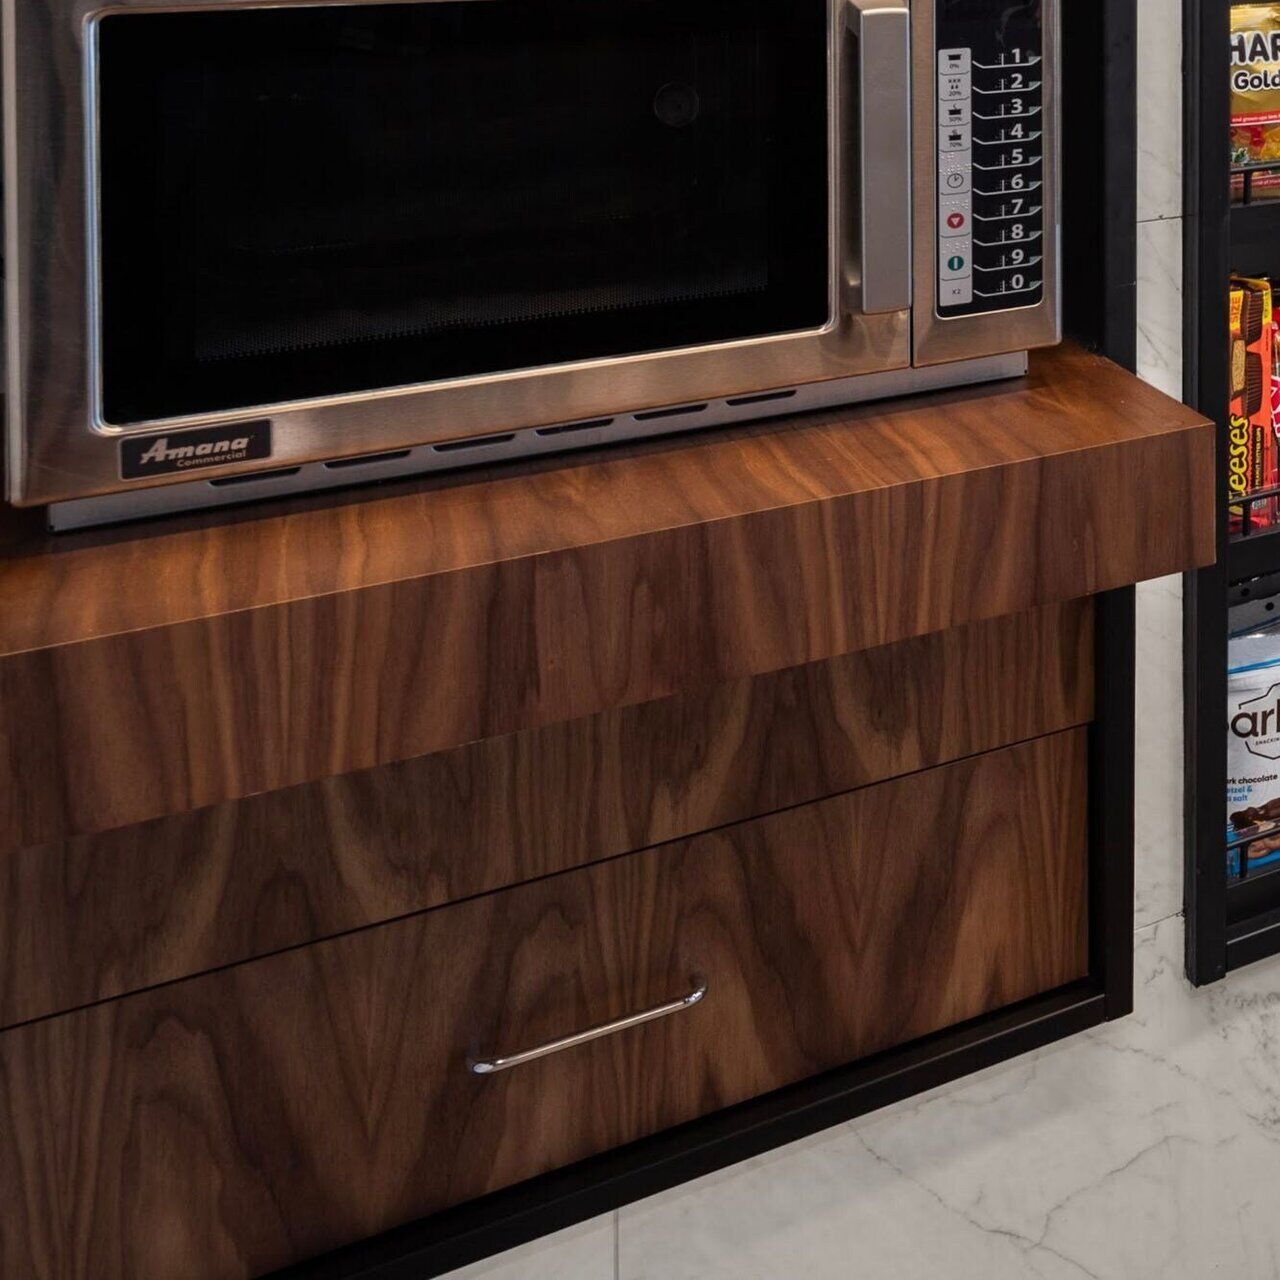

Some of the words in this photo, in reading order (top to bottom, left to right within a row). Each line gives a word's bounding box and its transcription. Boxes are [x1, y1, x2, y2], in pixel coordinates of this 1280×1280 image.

[1011, 49, 1022, 64] 1
[1011, 74, 1023, 89] 2
[1011, 99, 1023, 114] 3
[1011, 124, 1023, 138] 4
[1011, 149, 1023, 164] 5
[1011, 174, 1023, 189] 6
[1011, 200, 1023, 214] 7
[1011, 225, 1024, 239] 8
[1011, 249, 1024, 264] 9
[1011, 275, 1024, 289] 0
[1232, 297, 1241, 323] SIZE
[140, 437, 249, 464] Amana
[177, 450, 247, 468] Commercial
[1239, 773, 1278, 785] chocolate
